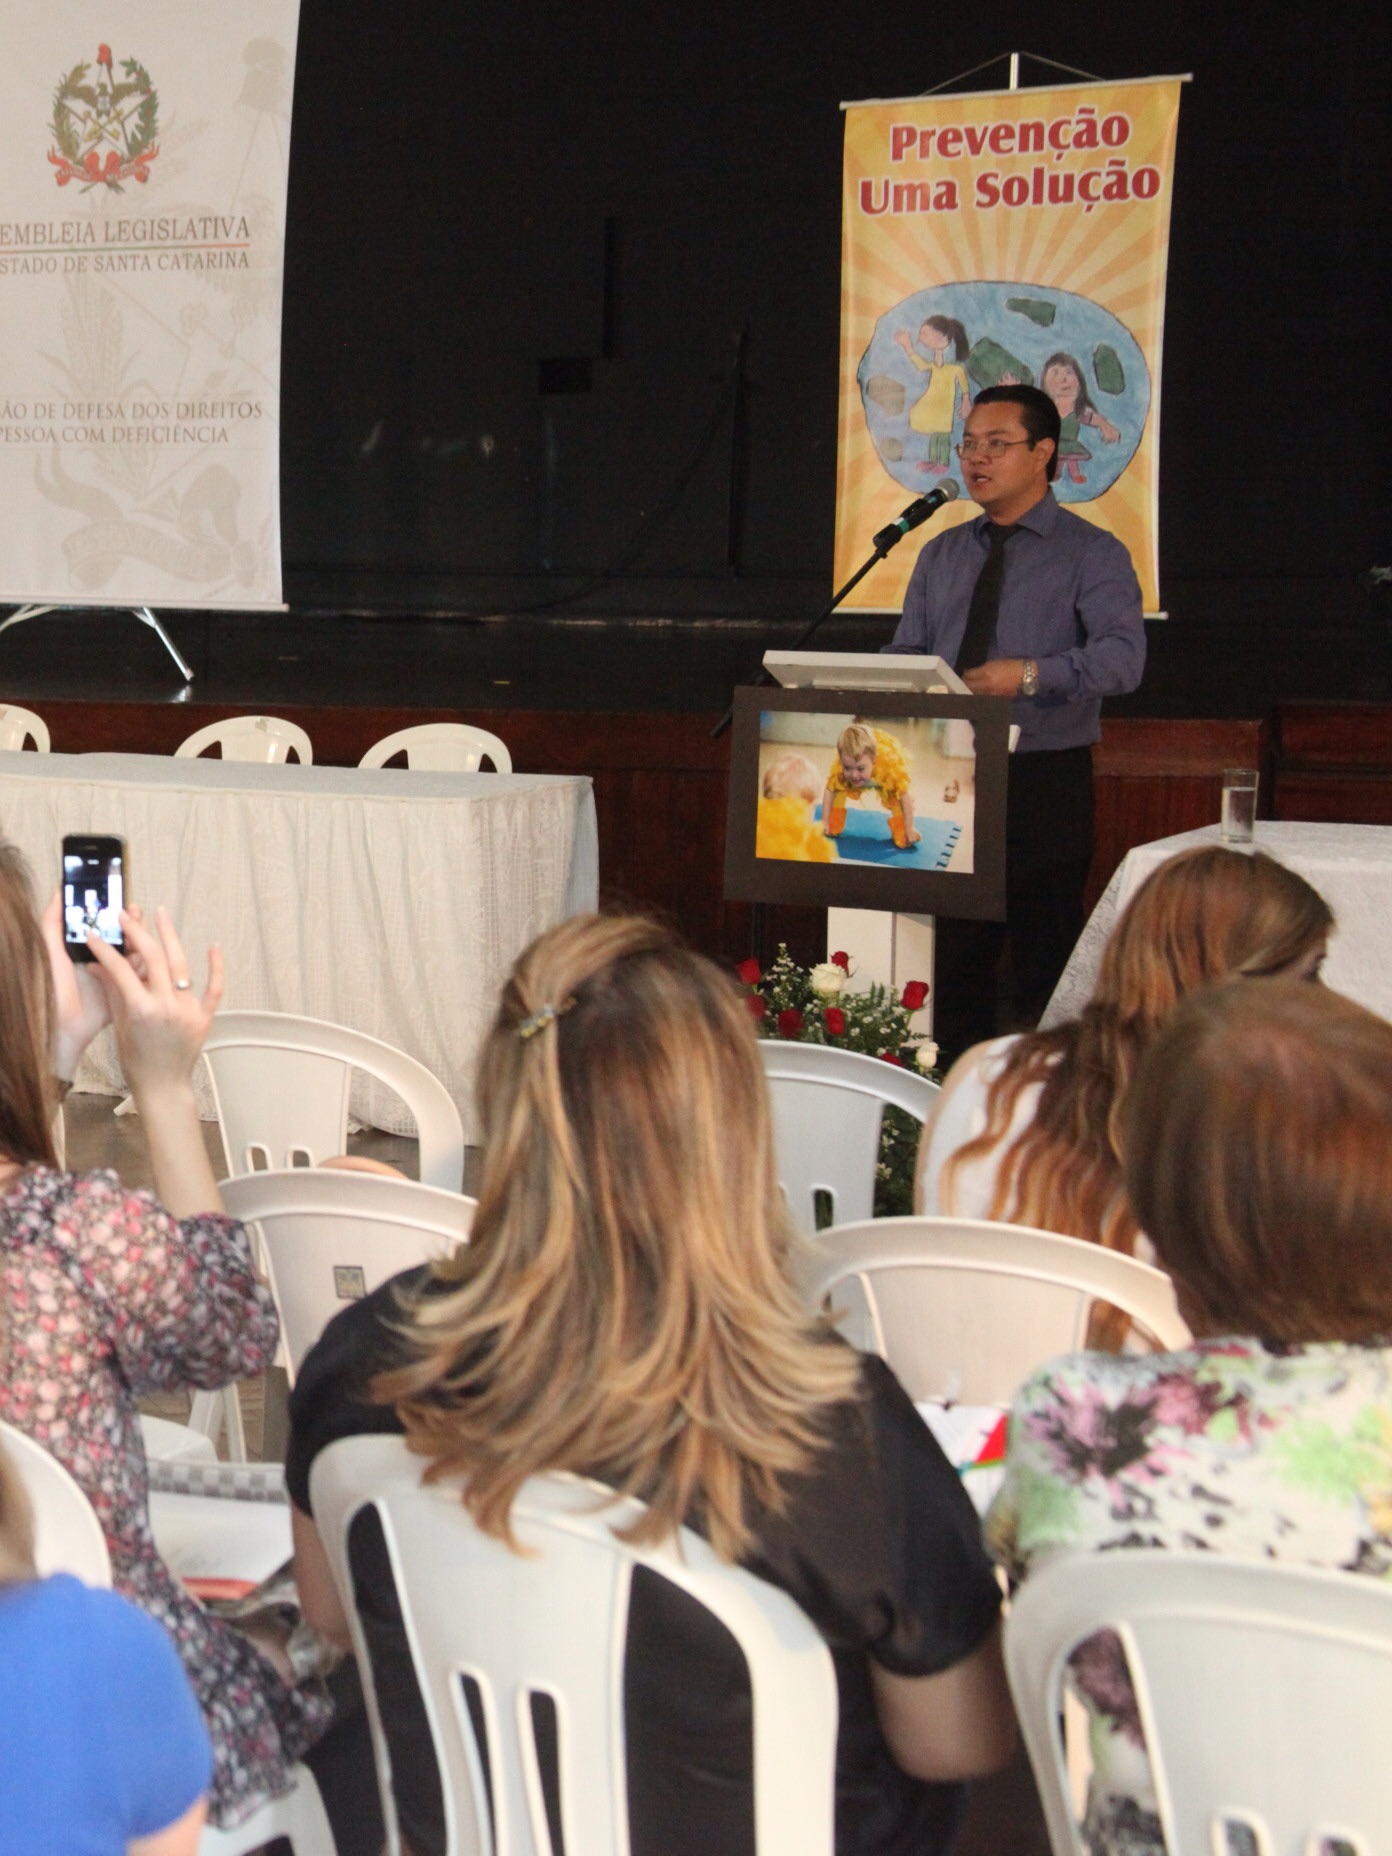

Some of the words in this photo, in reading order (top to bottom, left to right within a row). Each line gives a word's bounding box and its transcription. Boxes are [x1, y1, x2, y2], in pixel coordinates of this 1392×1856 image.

[890, 106, 1131, 163] Prevenção
[860, 177, 959, 215] Uma
[975, 159, 1162, 213] Solução
[104, 215, 250, 242] LEGISLATIVA
[64, 254, 89, 273] DE
[93, 253, 151, 272] SANTA
[157, 250, 250, 271] CATARINA
[34, 401, 57, 420] DE
[63, 401, 126, 420] DEFESA
[132, 401, 169, 420] DOS
[176, 400, 263, 420] DIREITOS
[61, 425, 107, 443] COM
[112, 422, 230, 443] DEFICIÊNCIA
